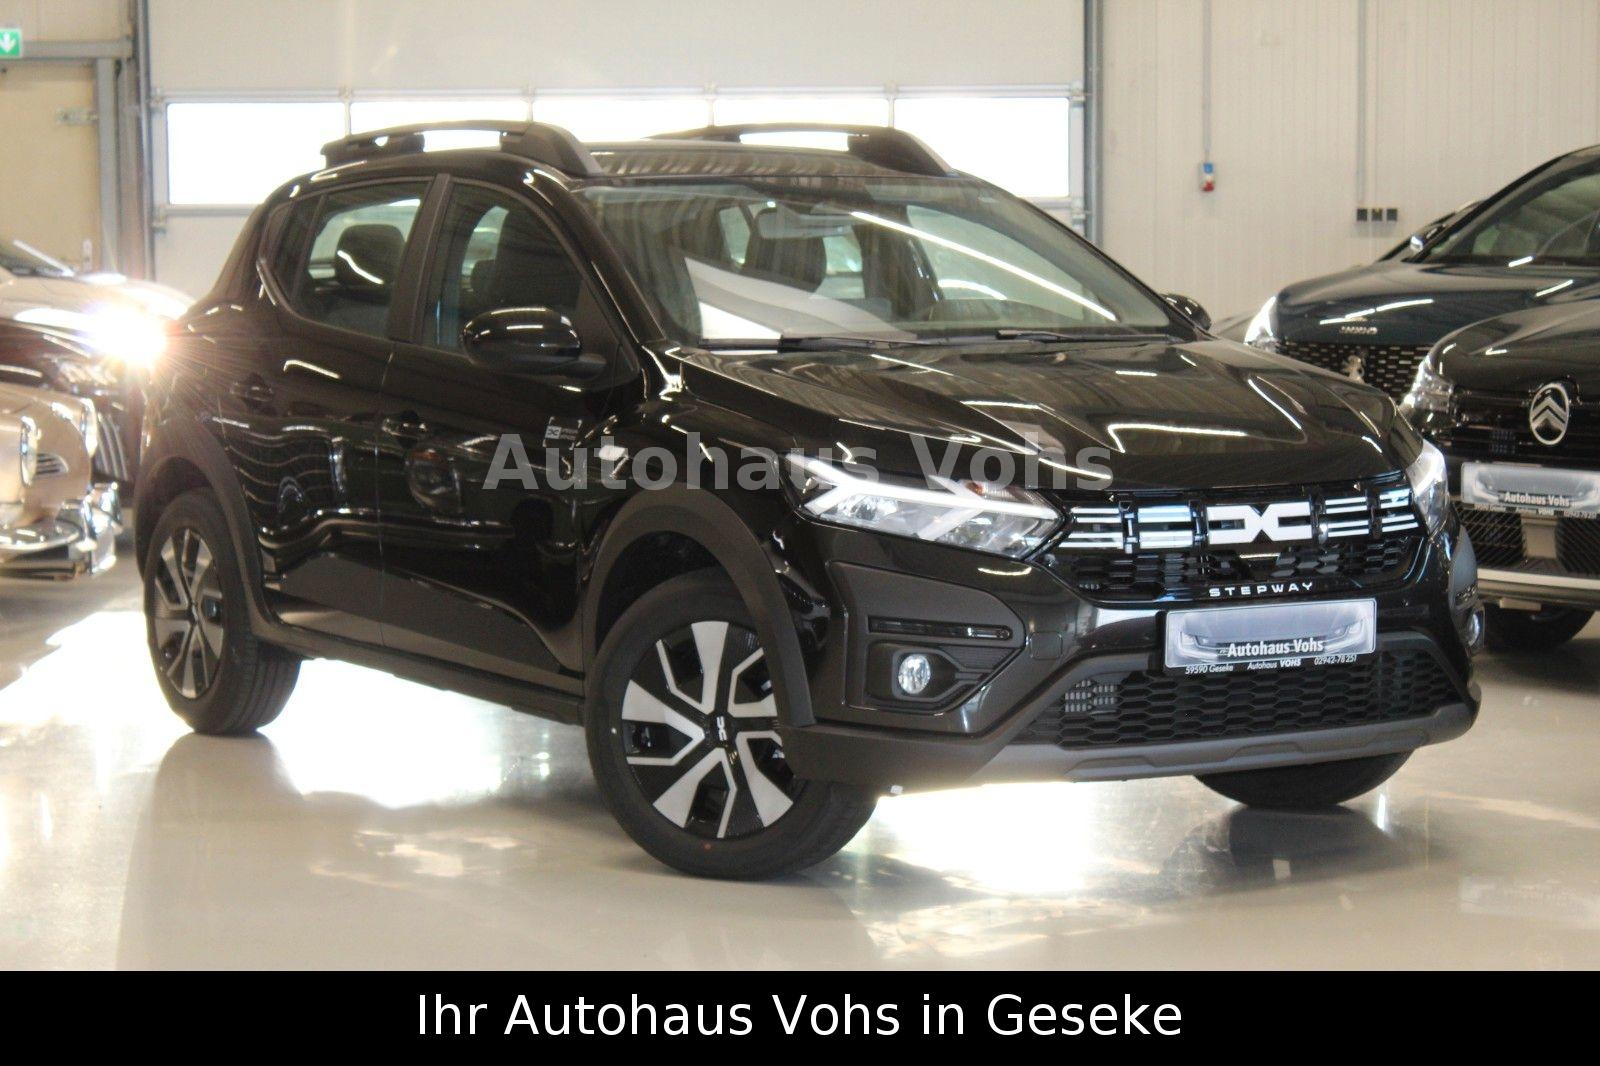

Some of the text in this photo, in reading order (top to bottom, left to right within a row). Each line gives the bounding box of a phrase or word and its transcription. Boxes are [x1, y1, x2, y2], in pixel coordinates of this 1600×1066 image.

[1209, 582, 1313, 597] STEPWAY
[1227, 637, 1324, 658] Autohaus Vohs
[1184, 664, 1208, 675] 59590
[1279, 658, 1302, 668] VOHS
